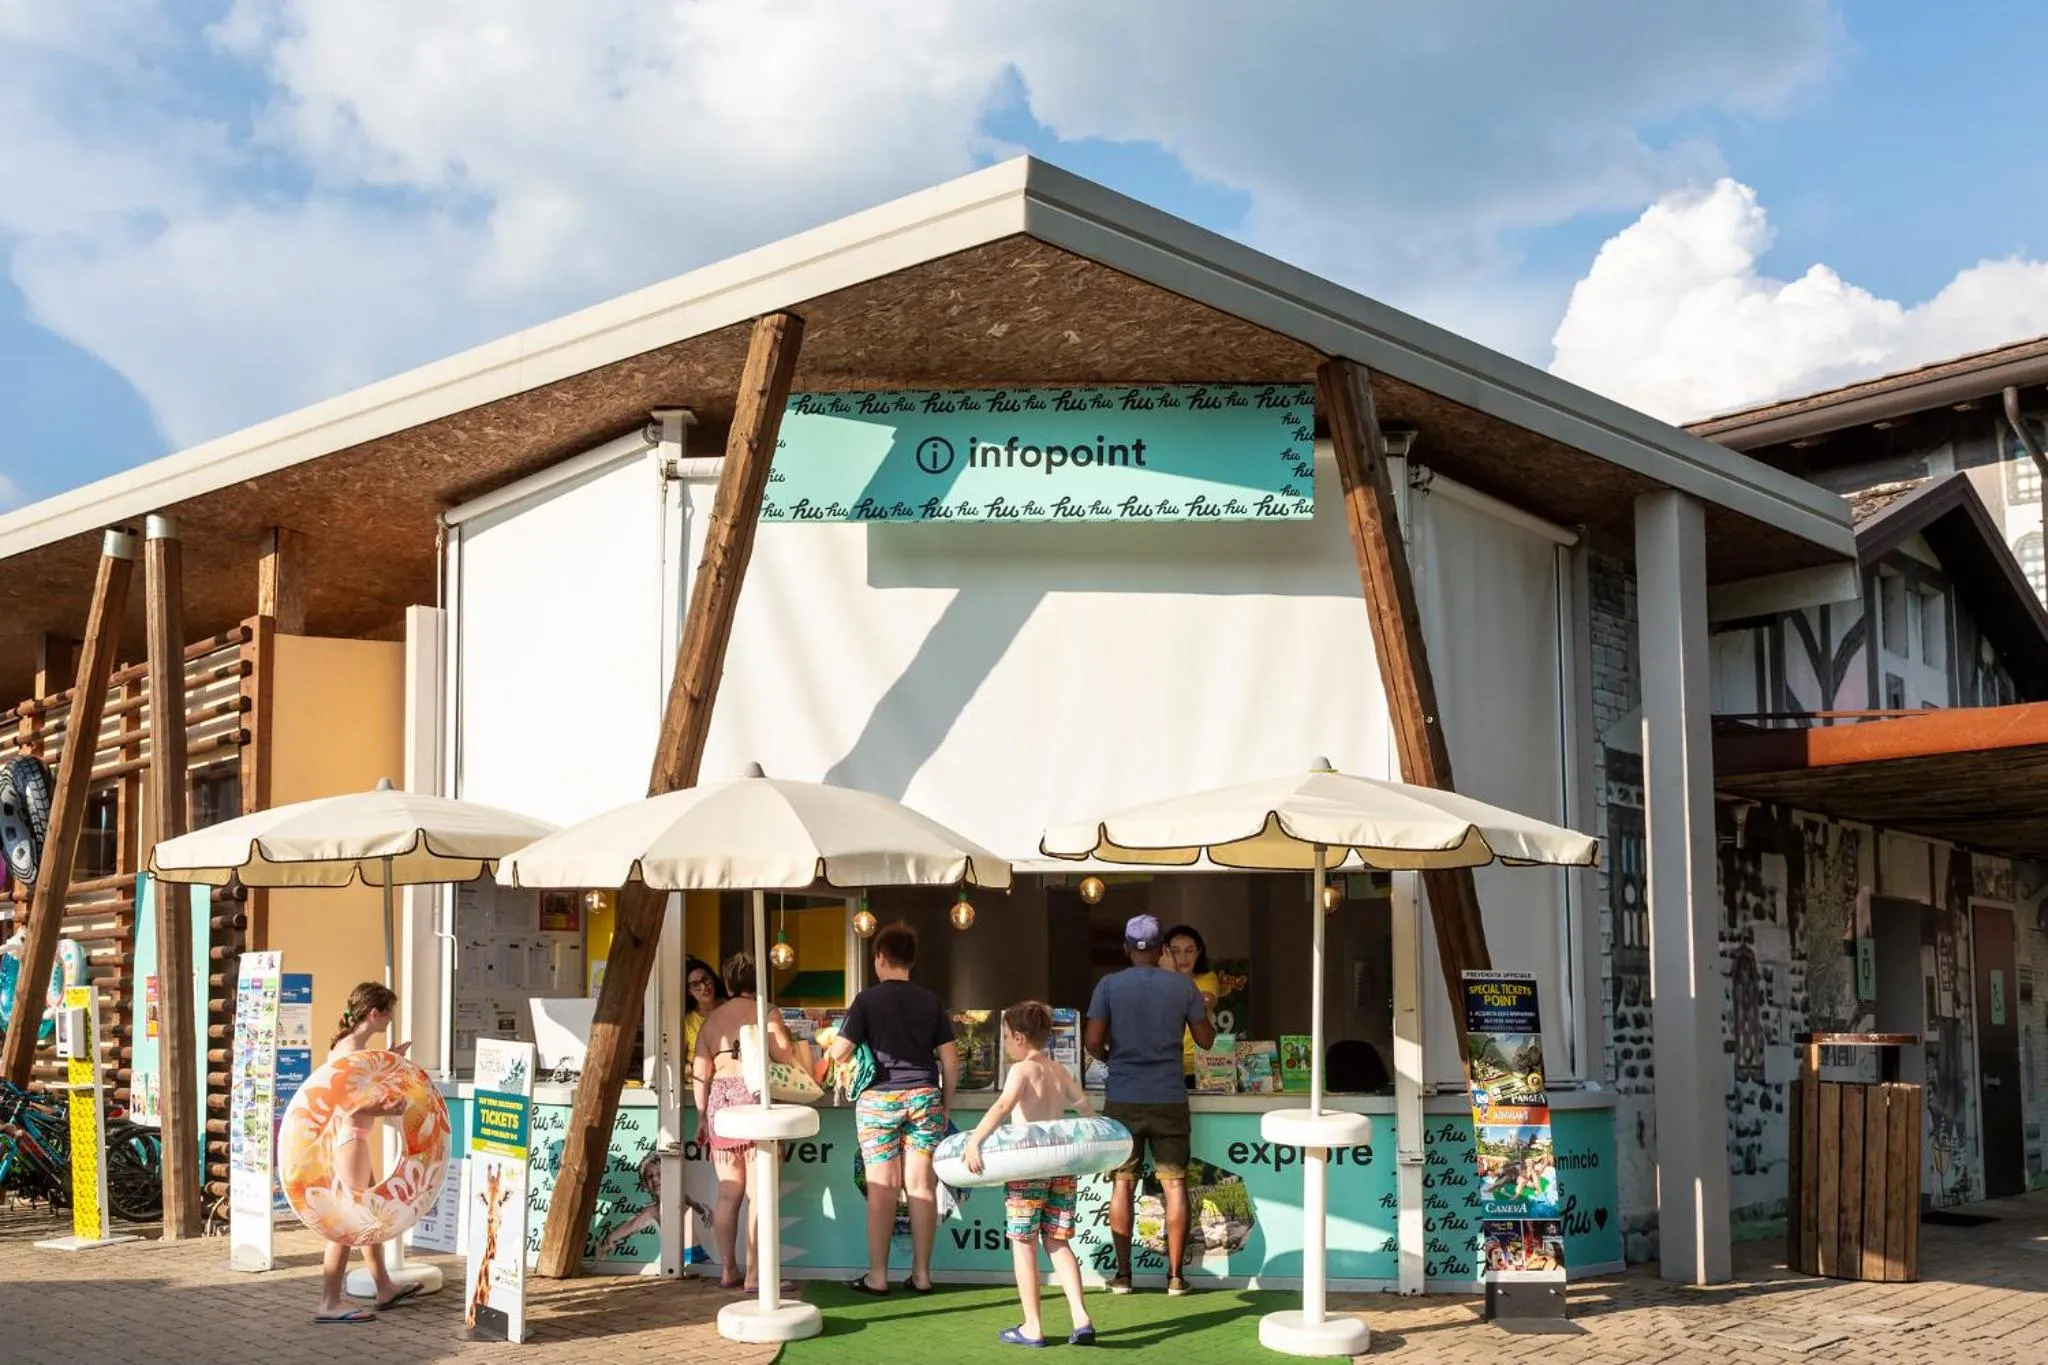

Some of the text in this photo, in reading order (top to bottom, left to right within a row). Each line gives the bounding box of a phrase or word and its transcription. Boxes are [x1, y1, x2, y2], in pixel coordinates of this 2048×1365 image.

[792, 394, 826, 415] hu
[827, 398, 850, 412] hu
[856, 393, 889, 414] hu
[890, 397, 915, 411] hu
[920, 392, 955, 413] hu
[958, 396, 981, 410] hu
[986, 391, 1020, 412] hu
[1024, 395, 1046, 409] hu
[1051, 390, 1087, 411] hu
[1090, 394, 1112, 408] hu
[1118, 389, 1154, 411] hu
[1156, 393, 1180, 408] hu
[1186, 388, 1221, 409] hu
[1222, 392, 1248, 406] hu
[1253, 387, 1291, 408] hu
[969, 435, 1146, 475] infopoint
[761, 503, 785, 517] hu
[789, 499, 823, 520] hu
[825, 502, 849, 517] hu
[853, 498, 889, 519] hu
[890, 502, 914, 517] hu
[918, 497, 953, 519] hu
[955, 501, 979, 516] hu
[984, 496, 1019, 518] hu
[1021, 500, 1045, 516] hu
[1050, 496, 1086, 518] hu
[1088, 500, 1112, 515] hu
[1117, 495, 1153, 517] hu
[1155, 499, 1179, 514] hu
[1184, 495, 1221, 517] hu
[1222, 499, 1248, 514] hu
[1252, 495, 1290, 516] hu
[1469, 984, 1532, 996] SPECIAL TICKETS
[1484, 995, 1517, 1007] POINT
[480, 1109, 519, 1129] TICKETS
[1437, 1124, 1467, 1142] hu
[1425, 1151, 1448, 1165] hu
[1437, 1168, 1467, 1186] hu
[1077, 1187, 1102, 1201] hu
[1425, 1194, 1448, 1209] hu
[1439, 1212, 1468, 1230] hu
[1560, 1194, 1591, 1237] hu
[1426, 1238, 1449, 1252] hu
[1134, 1251, 1164, 1268] hu
[1440, 1256, 1469, 1275] hu
